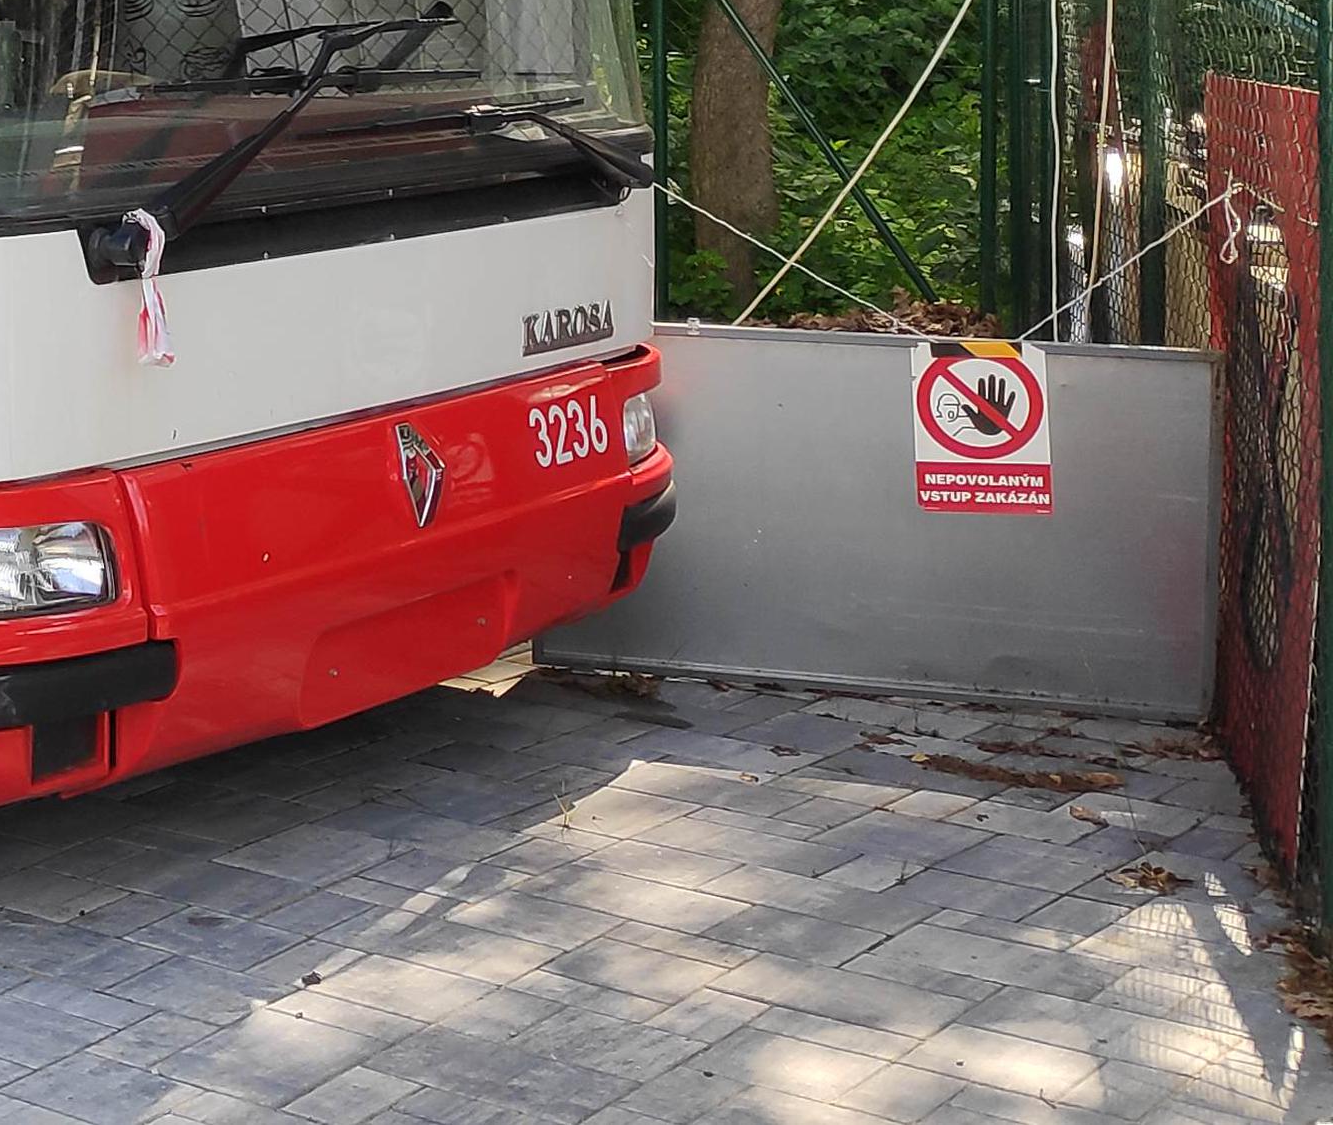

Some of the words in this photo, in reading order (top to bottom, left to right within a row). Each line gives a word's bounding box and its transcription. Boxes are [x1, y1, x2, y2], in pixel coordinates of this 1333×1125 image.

[522, 299, 614, 349] KAROSA
[528, 394, 610, 469] 3236
[924, 472, 1044, 488] NEPOVOLANÝM
[919, 490, 972, 503] VSTUP
[975, 489, 1051, 506] ZAKÁZÁN
